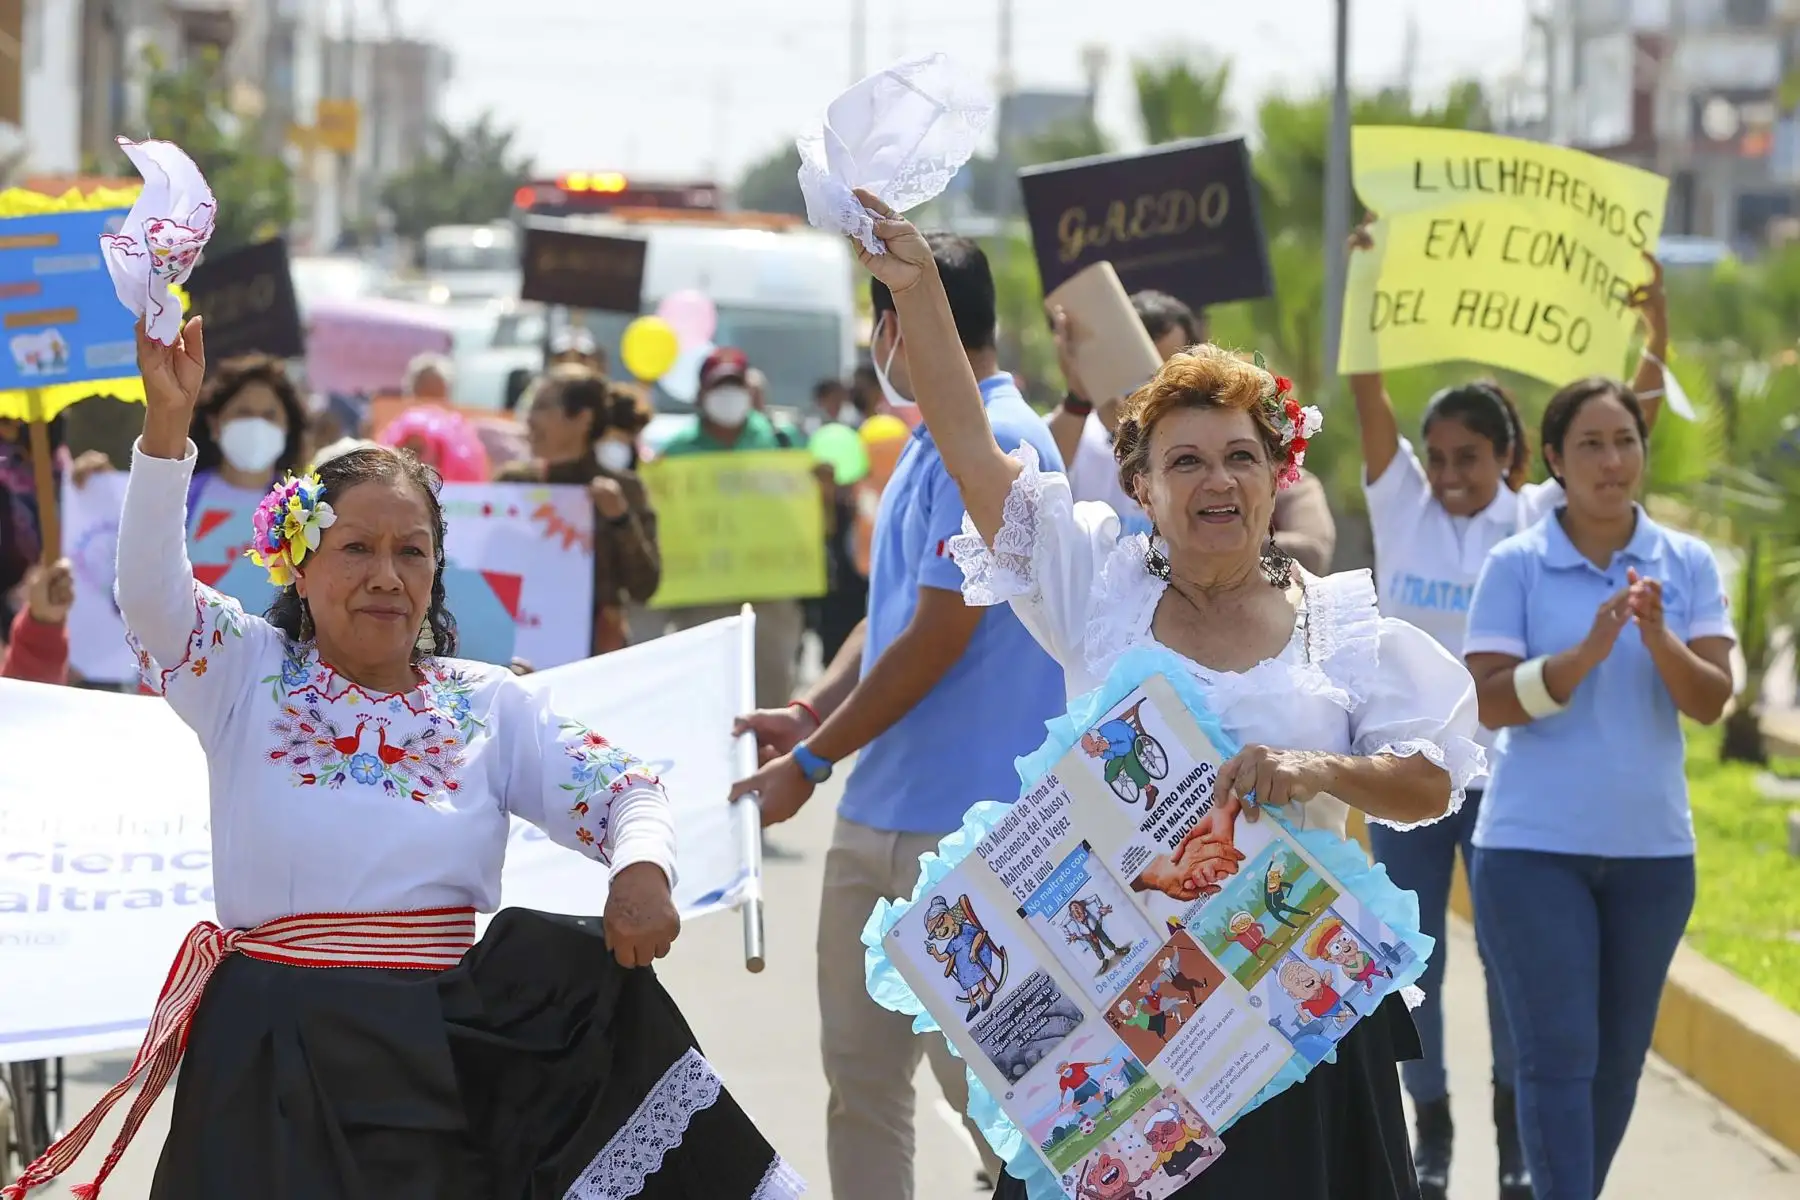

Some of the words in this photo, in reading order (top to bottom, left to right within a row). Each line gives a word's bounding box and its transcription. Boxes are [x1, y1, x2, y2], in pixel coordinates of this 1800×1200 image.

[1414, 156, 1653, 250] LUCHAREMOS
[1424, 218, 1485, 261] EN
[1501, 223, 1634, 321] CONTRA
[1370, 286, 1428, 333] DEL
[1452, 288, 1592, 356] ABUSO
[1176, 762, 1213, 794] MUNDO,
[975, 841, 994, 859] Día
[988, 810, 1021, 846] Mundial
[1017, 803, 1030, 817] de
[1025, 784, 1049, 806] Toma
[1045, 774, 1059, 788] de
[988, 831, 1030, 873] Conciencia
[1026, 815, 1042, 835] del
[1038, 796, 1063, 823] Abuso
[1060, 790, 1070, 804] y
[1153, 824, 1169, 842] SIN
[1166, 783, 1206, 828] MALTRATO
[1167, 815, 1197, 850] ADULTO
[999, 854, 1033, 888] Maltrato
[1031, 844, 1043, 858] en
[1037, 836, 1050, 849] la
[1044, 815, 1070, 839] Vejez
[1012, 885, 1026, 902] 15
[1023, 878, 1036, 892] de
[1030, 860, 1053, 883] junio
[1026, 899, 1040, 912] No
[1039, 867, 1071, 900] maltrato
[1070, 852, 1085, 868] con
[1043, 903, 1053, 914] la
[1095, 981, 1108, 993] De
[1116, 937, 1148, 968] Adultos
[974, 1013, 991, 1031] Tener
[990, 989, 1020, 1018] paciencia
[1017, 978, 1029, 991] con
[1028, 970, 1038, 981] un
[975, 1022, 996, 1042] adulto
[995, 1005, 1014, 1027] mayor
[1019, 973, 1049, 1001] construir
[994, 1020, 1015, 1041] puente
[1013, 1010, 1027, 1023] por
[1024, 992, 1043, 1012] donde
[1017, 1021, 1029, 1031] vas
[1049, 990, 1059, 1001] No
[1028, 1016, 1047, 1034] olvide
[1169, 1044, 1181, 1056] vejez
[1188, 1021, 1199, 1035] edad
[1175, 1048, 1198, 1075] atardeceres
[1203, 1027, 1217, 1041] todos
[1221, 1007, 1235, 1023] paran
[1188, 1036, 1198, 1049] pero
[1196, 1028, 1206, 1038] hay
[1199, 1092, 1209, 1103] Los
[1208, 1082, 1220, 1095] años
[1218, 1065, 1235, 1084] arrugan
[1205, 1087, 1225, 1109] renunciar
[1229, 1058, 1254, 1084] entusiasmo
[1253, 1042, 1270, 1059] arruga
